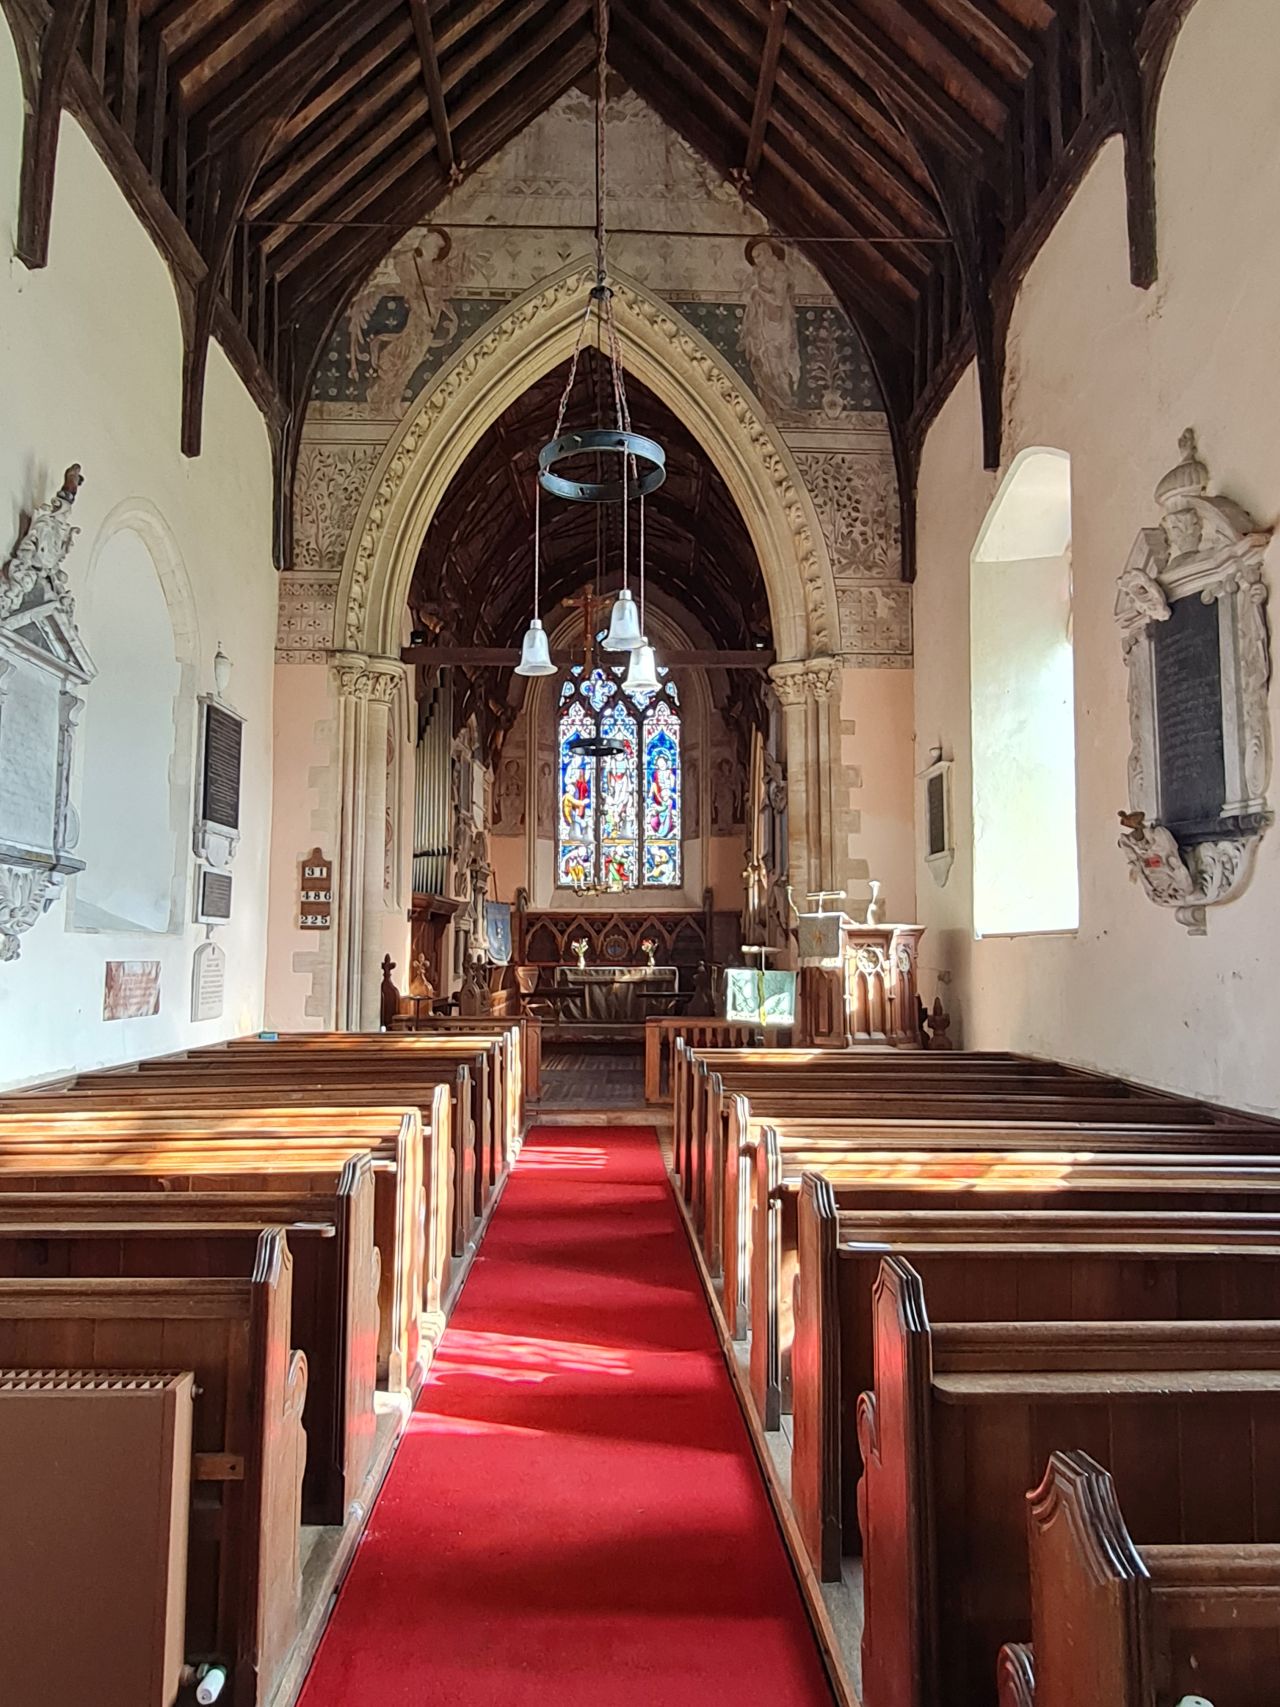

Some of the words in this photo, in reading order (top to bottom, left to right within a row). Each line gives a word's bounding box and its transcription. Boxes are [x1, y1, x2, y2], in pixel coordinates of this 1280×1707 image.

[307, 867, 324, 877] 31
[302, 891, 332, 901] 486
[300, 915, 328, 925] 225
